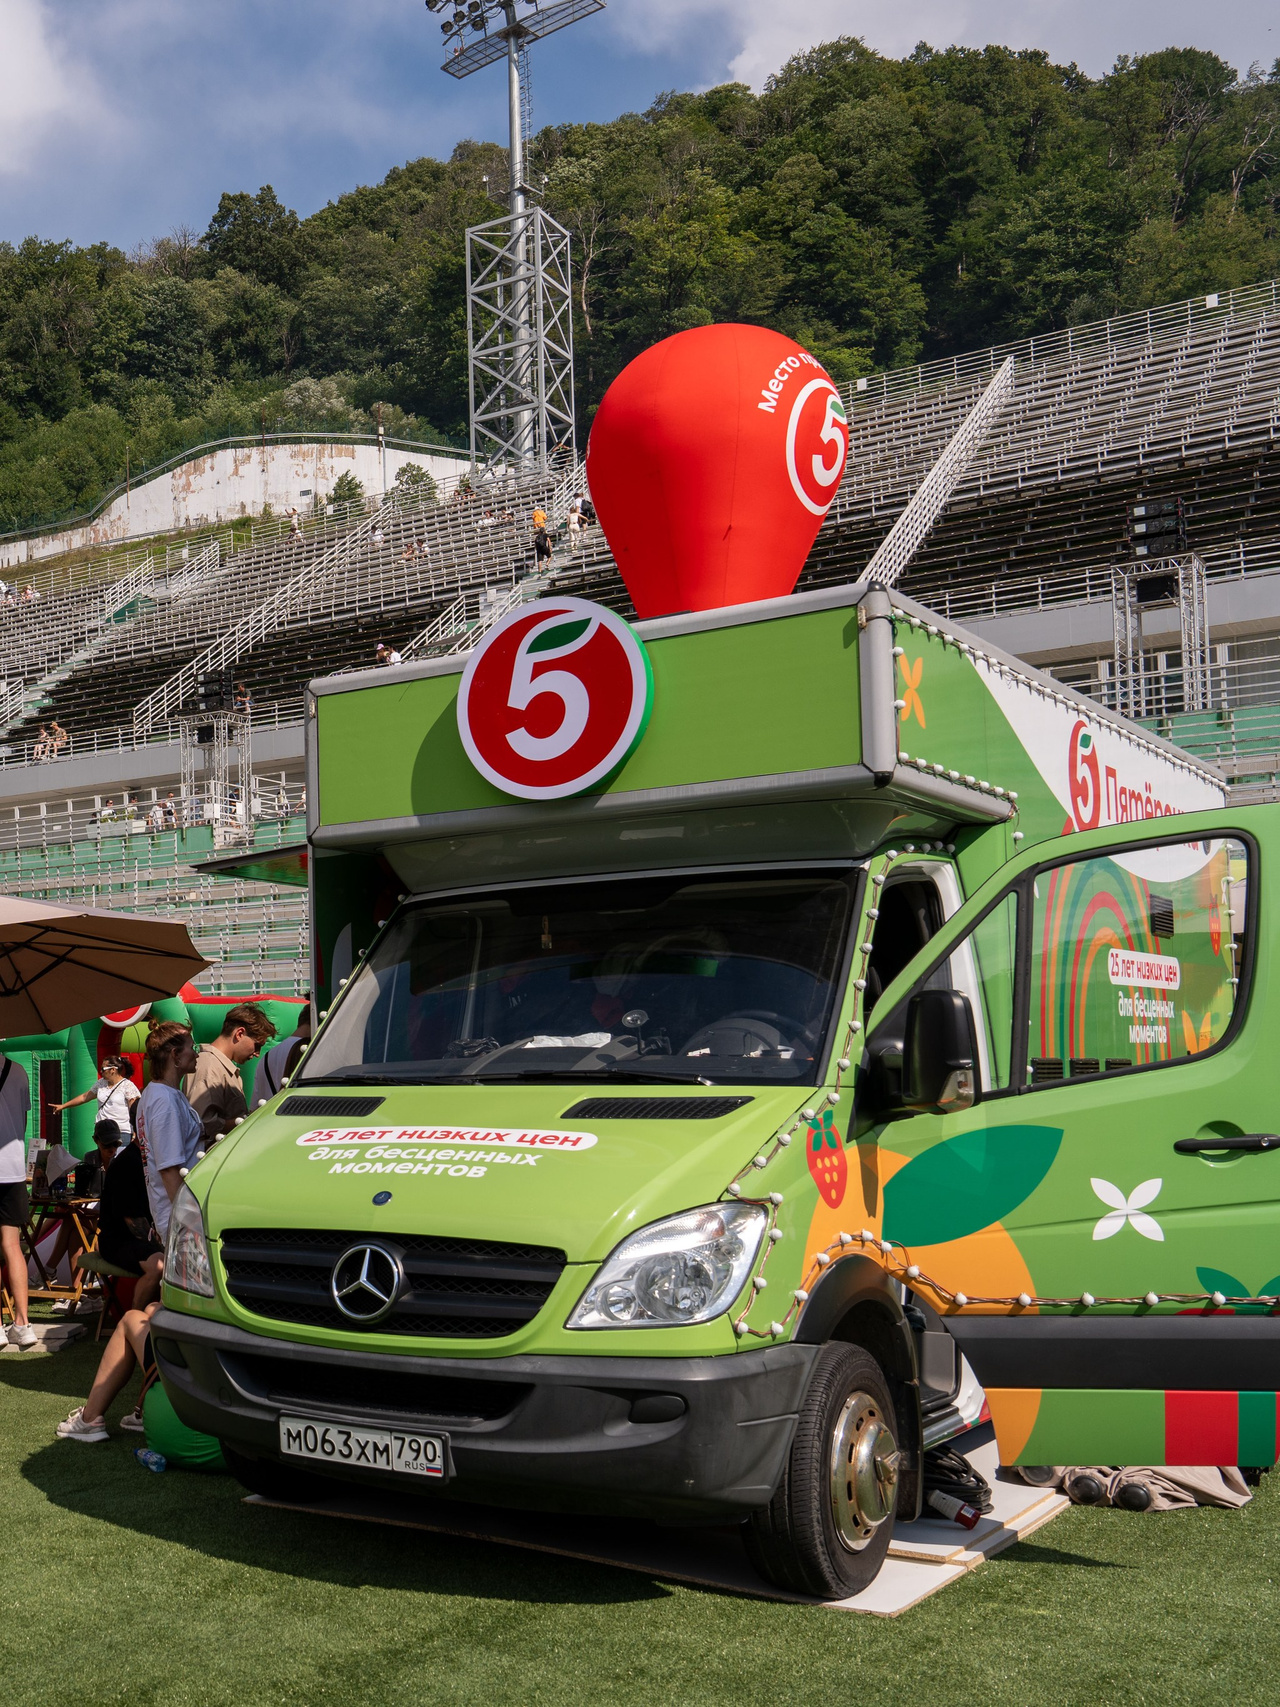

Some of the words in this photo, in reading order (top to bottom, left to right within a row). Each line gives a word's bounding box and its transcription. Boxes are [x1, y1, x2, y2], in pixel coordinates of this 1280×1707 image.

[757, 355, 801, 414] Место
[1110, 952, 1120, 977] 25
[1121, 959, 1136, 979] лет
[1136, 961, 1164, 981] низких
[1164, 964, 1178, 985] цен
[1118, 990, 1133, 1016] для
[1134, 992, 1175, 1021] бесценных
[1129, 1025, 1167, 1043] моментов
[303, 1129, 339, 1143] 25
[337, 1129, 394, 1141] лет
[396, 1129, 512, 1143] низких
[515, 1133, 585, 1147] цен
[307, 1146, 363, 1161] для
[364, 1145, 544, 1166] бесценных
[328, 1161, 488, 1178] моментов
[393, 1435, 438, 1464] 790
[404, 1460, 426, 1472] RUS
